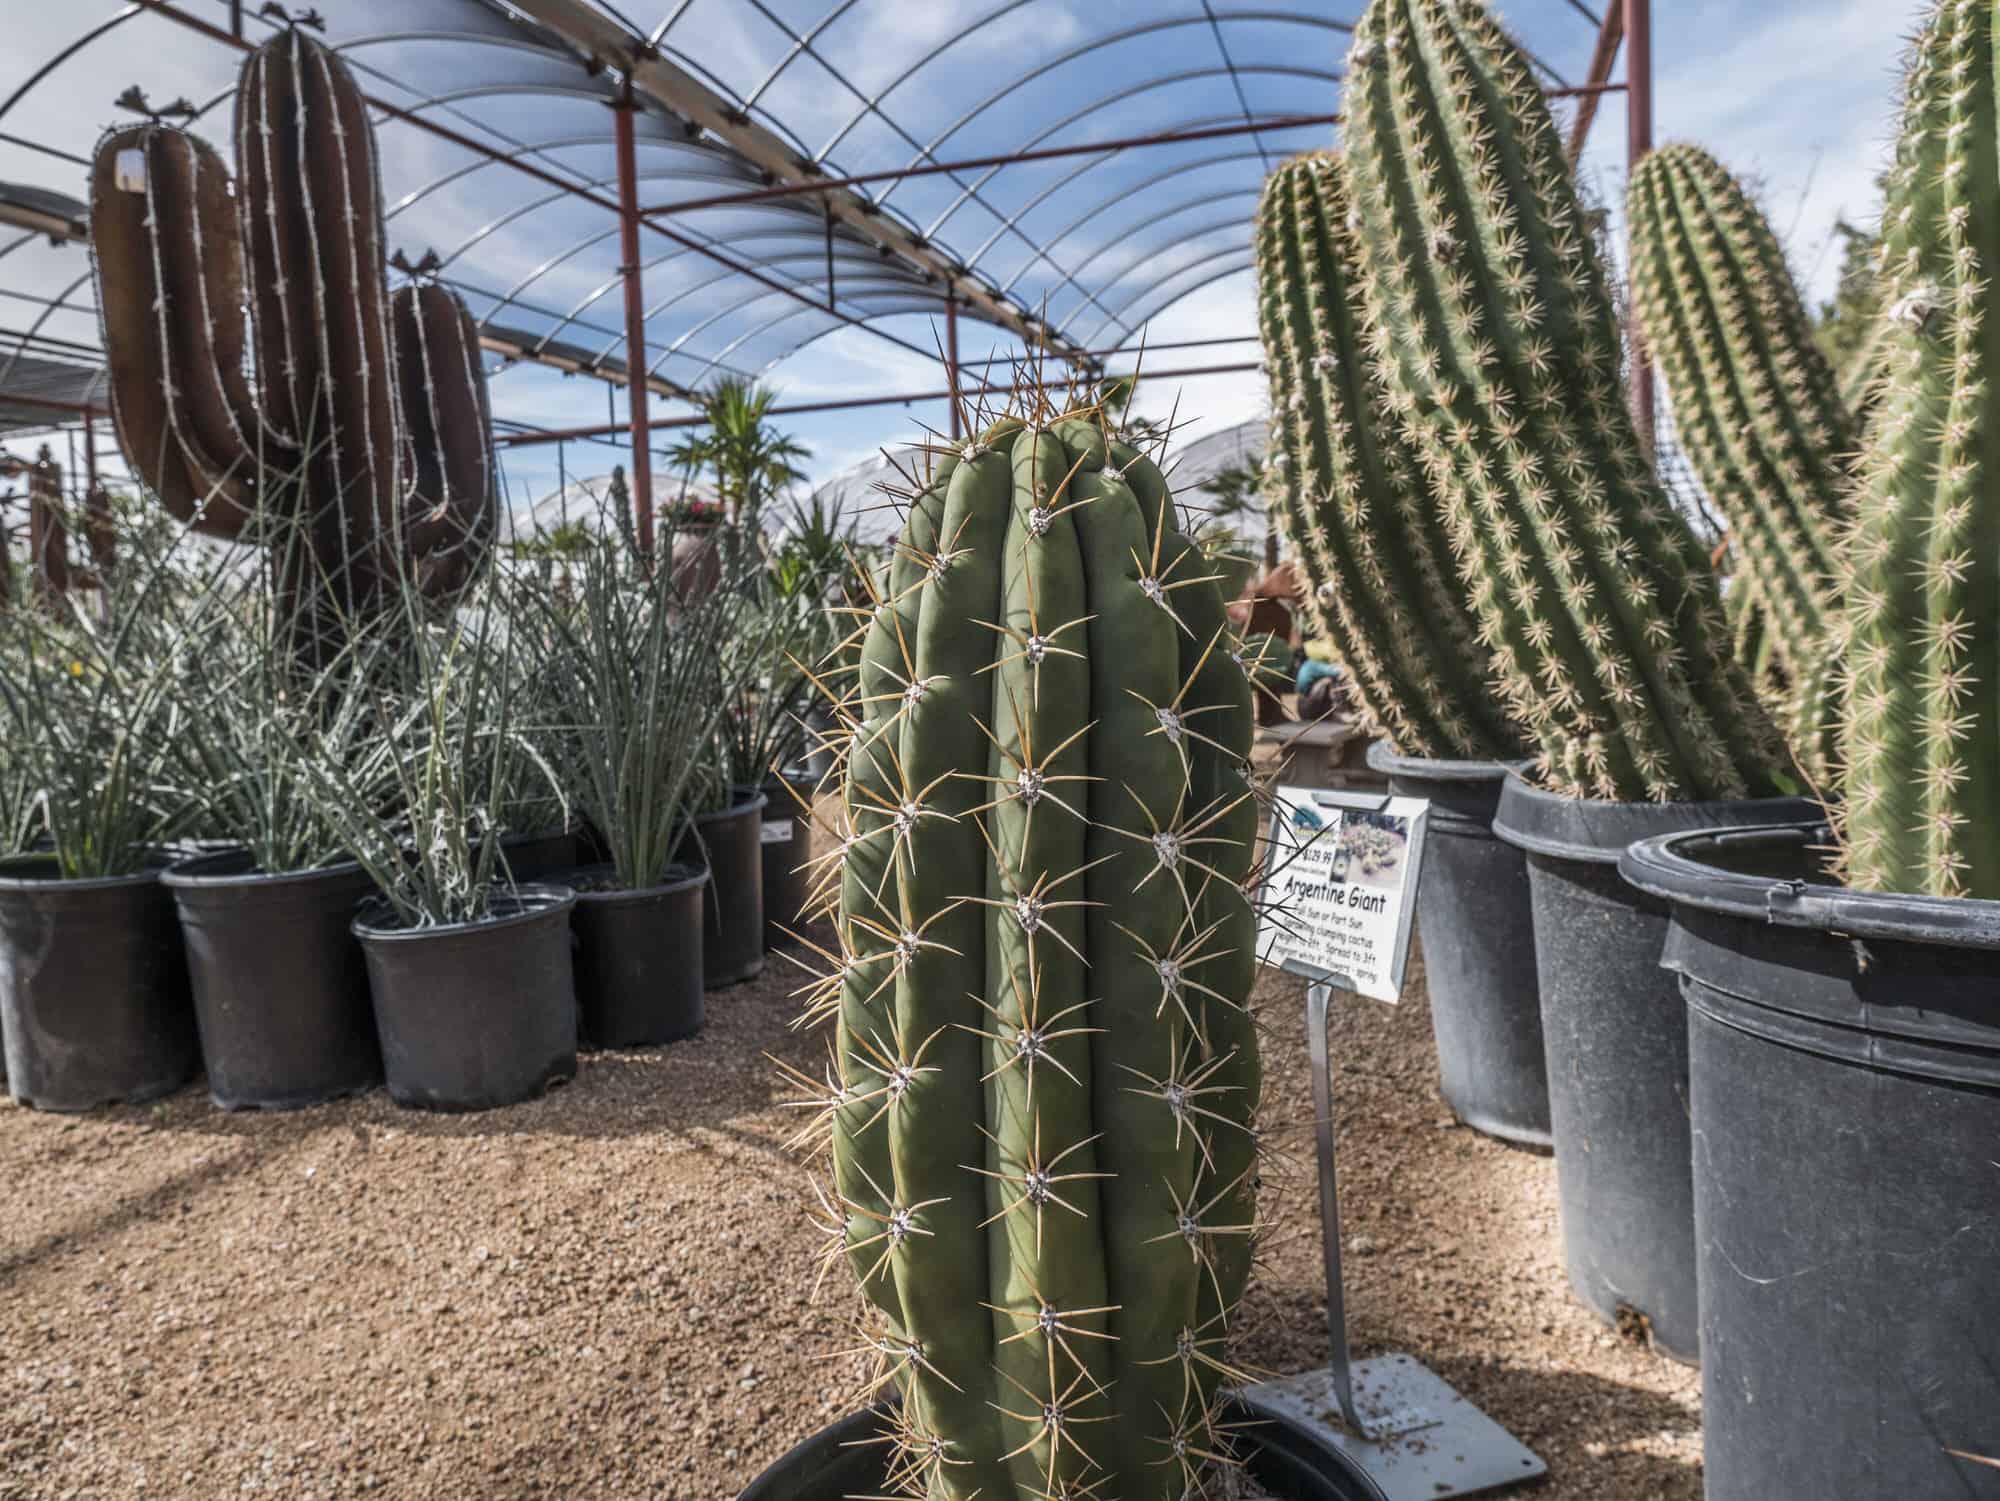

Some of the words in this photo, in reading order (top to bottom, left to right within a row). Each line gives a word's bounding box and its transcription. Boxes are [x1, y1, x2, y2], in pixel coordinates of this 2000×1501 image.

[1284, 875, 1345, 904] Argentine
[1349, 886, 1386, 915] Giant
[1331, 912, 1347, 924] Part
[1348, 918, 1363, 929] Sun
[1348, 935, 1373, 948] cactus
[1325, 943, 1351, 959] Spread
[1353, 951, 1360, 961] to
